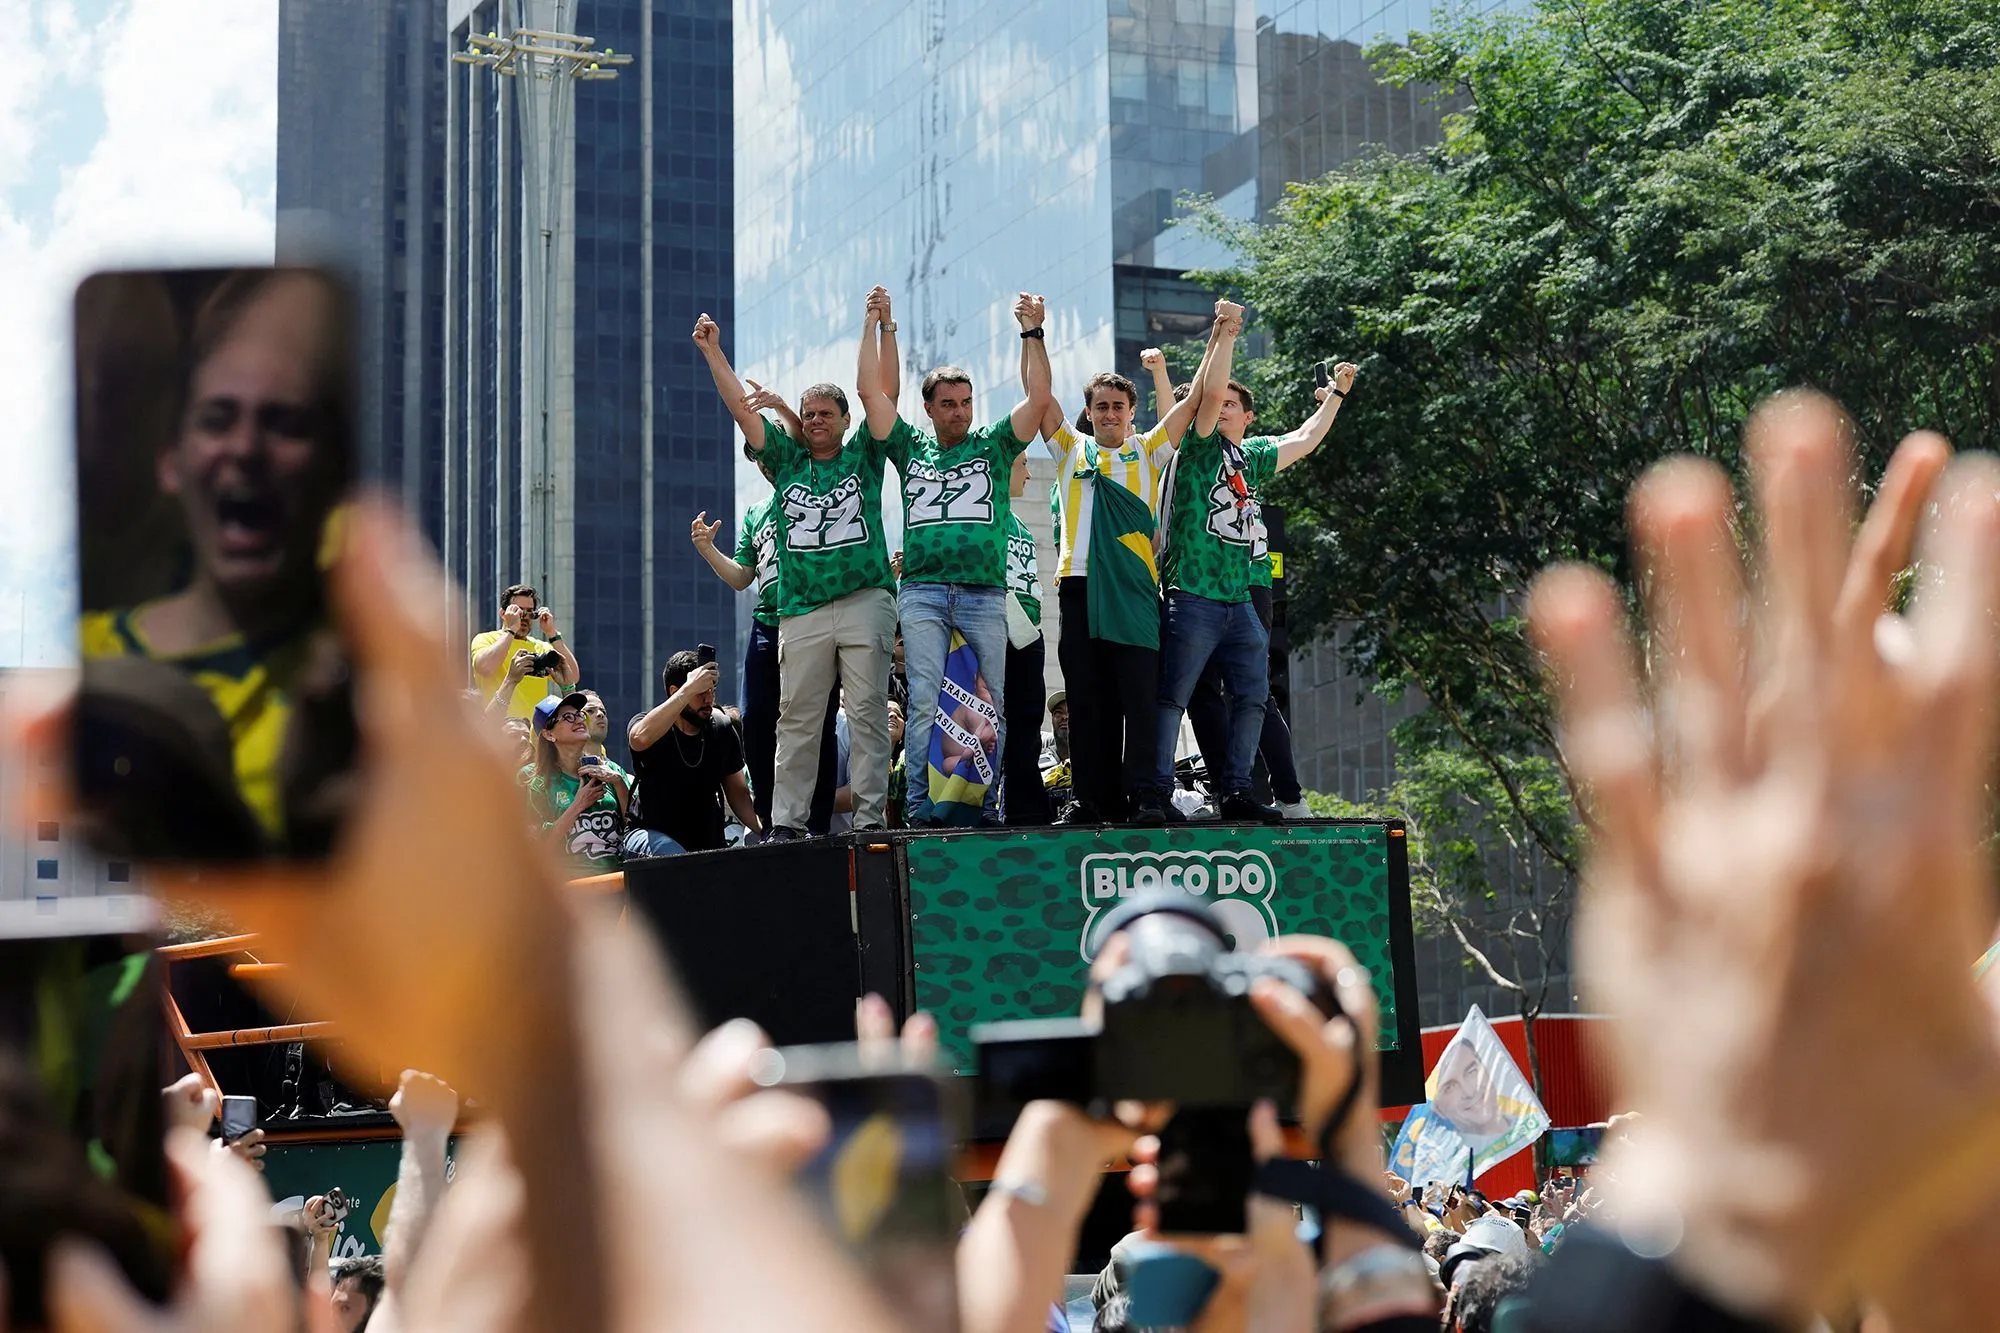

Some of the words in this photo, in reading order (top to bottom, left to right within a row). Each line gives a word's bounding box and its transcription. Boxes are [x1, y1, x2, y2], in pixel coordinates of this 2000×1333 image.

[960, 462, 986, 477] DO
[834, 478, 858, 502] DO
[905, 472, 989, 524] 22
[783, 491, 865, 546] 22
[941, 680, 975, 709] BRASIL
[977, 703, 996, 720] SEM
[935, 709, 956, 736] ASIL
[1093, 864, 1210, 899] BLOCO
[1217, 863, 1266, 895] DO
